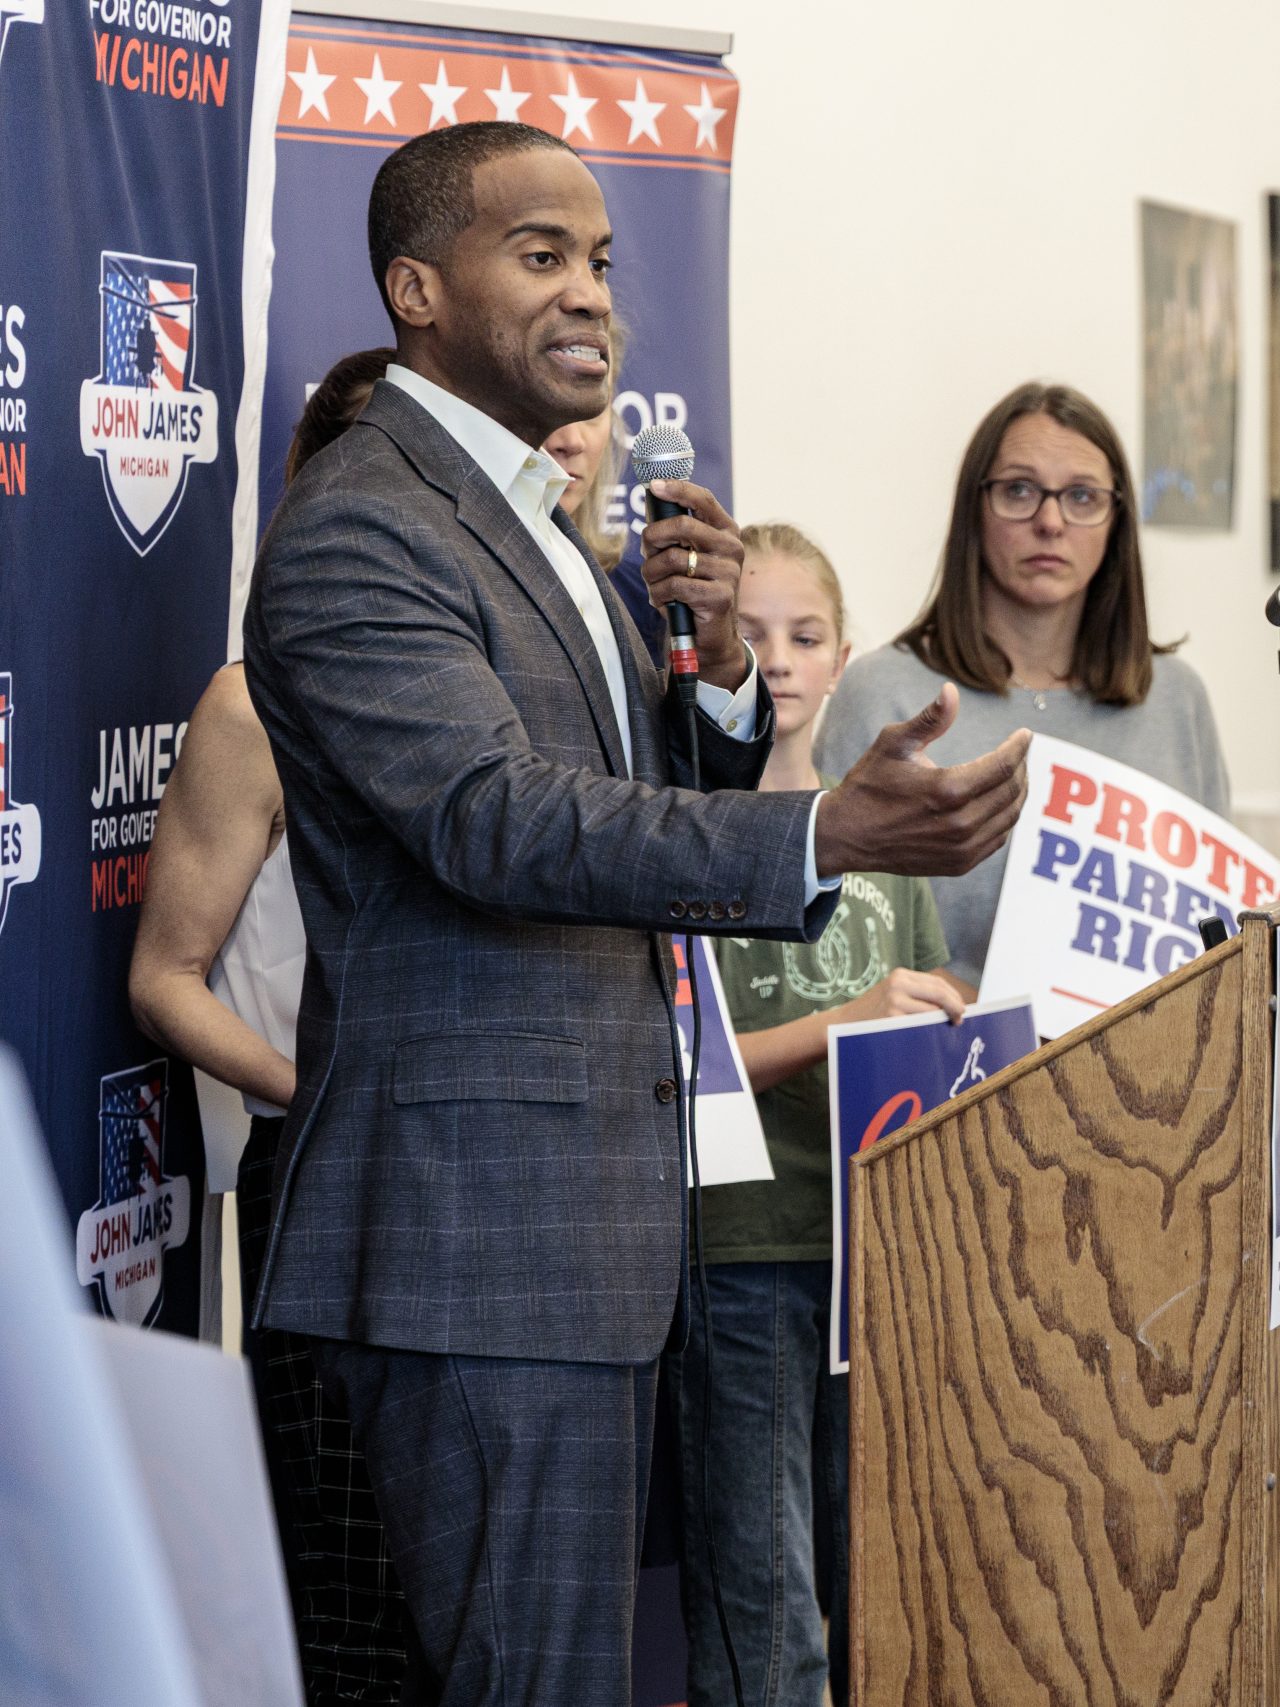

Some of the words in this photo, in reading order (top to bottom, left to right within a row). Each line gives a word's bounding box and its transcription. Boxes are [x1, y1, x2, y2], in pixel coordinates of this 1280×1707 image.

[89, 0, 130, 27] FOR
[134, 0, 232, 48] GOVERNOR
[93, 30, 229, 108] MICHIGAN
[92, 397, 139, 438] JOHN
[142, 405, 203, 443] JAMES
[120, 456, 169, 478] MICHIGAN
[91, 817, 117, 851] FOR
[91, 852, 150, 913] MICHI
[90, 1210, 131, 1264] JOHN
[133, 1192, 173, 1247] JAMES
[115, 1258, 157, 1292] MICHIGAN
